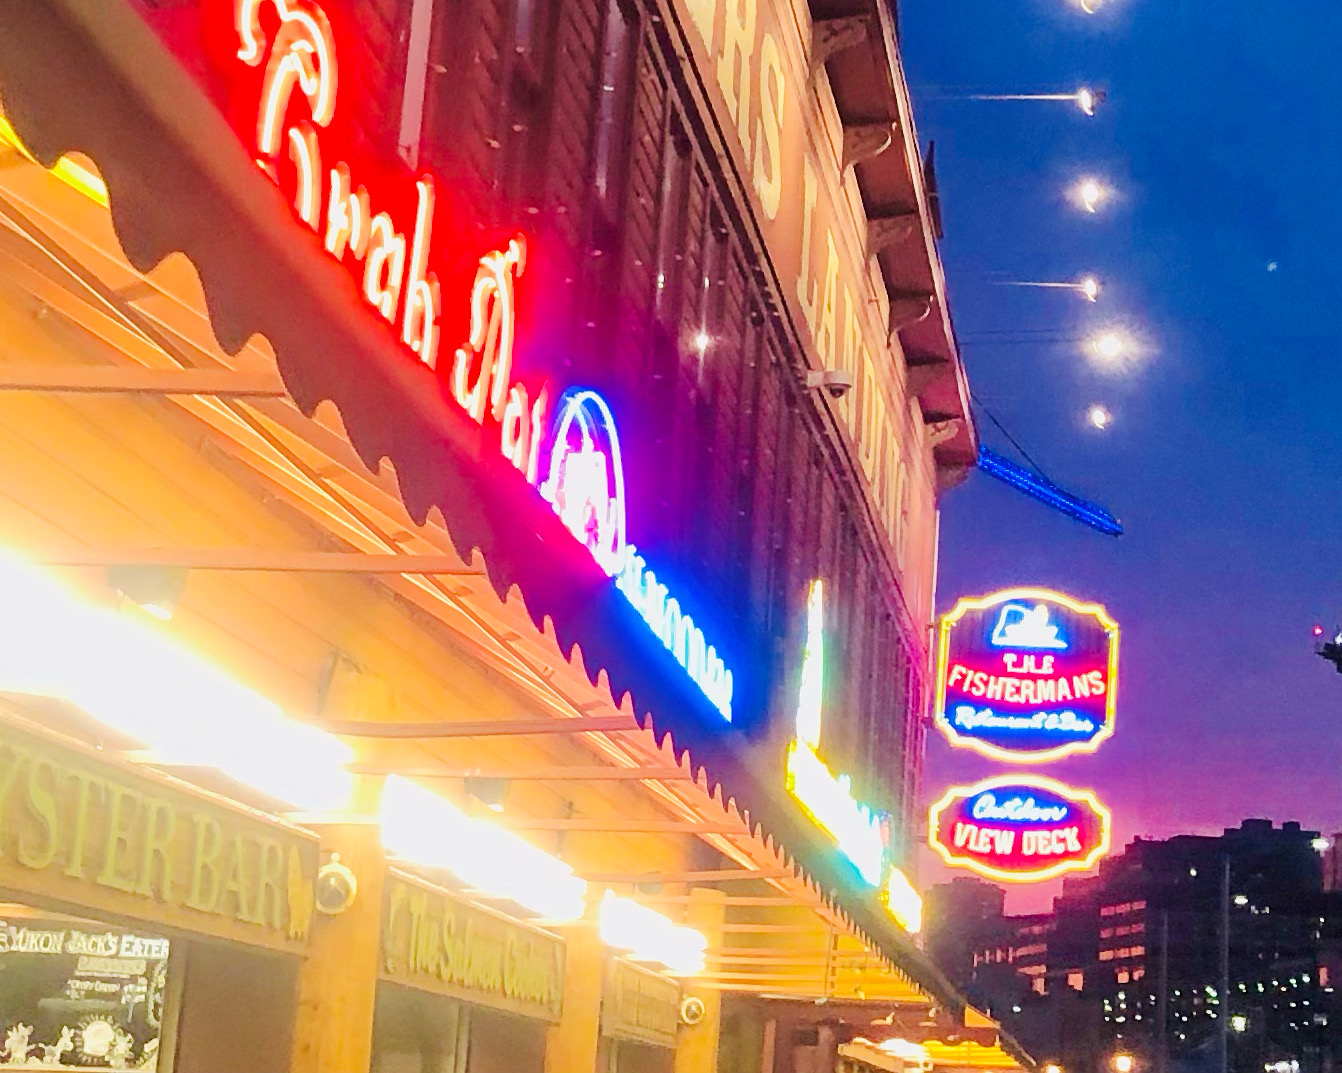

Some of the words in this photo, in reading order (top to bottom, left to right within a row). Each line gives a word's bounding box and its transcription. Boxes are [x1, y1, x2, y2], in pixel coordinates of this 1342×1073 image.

[1003, 653, 1055, 674] THE
[948, 664, 1106, 705] FISHERMANS
[953, 822, 1015, 855] VIEW
[1022, 826, 1082, 856] DECK
[186, 813, 284, 930] BAR
[9, 926, 65, 954] YUKON
[65, 930, 119, 956] JACK'S
